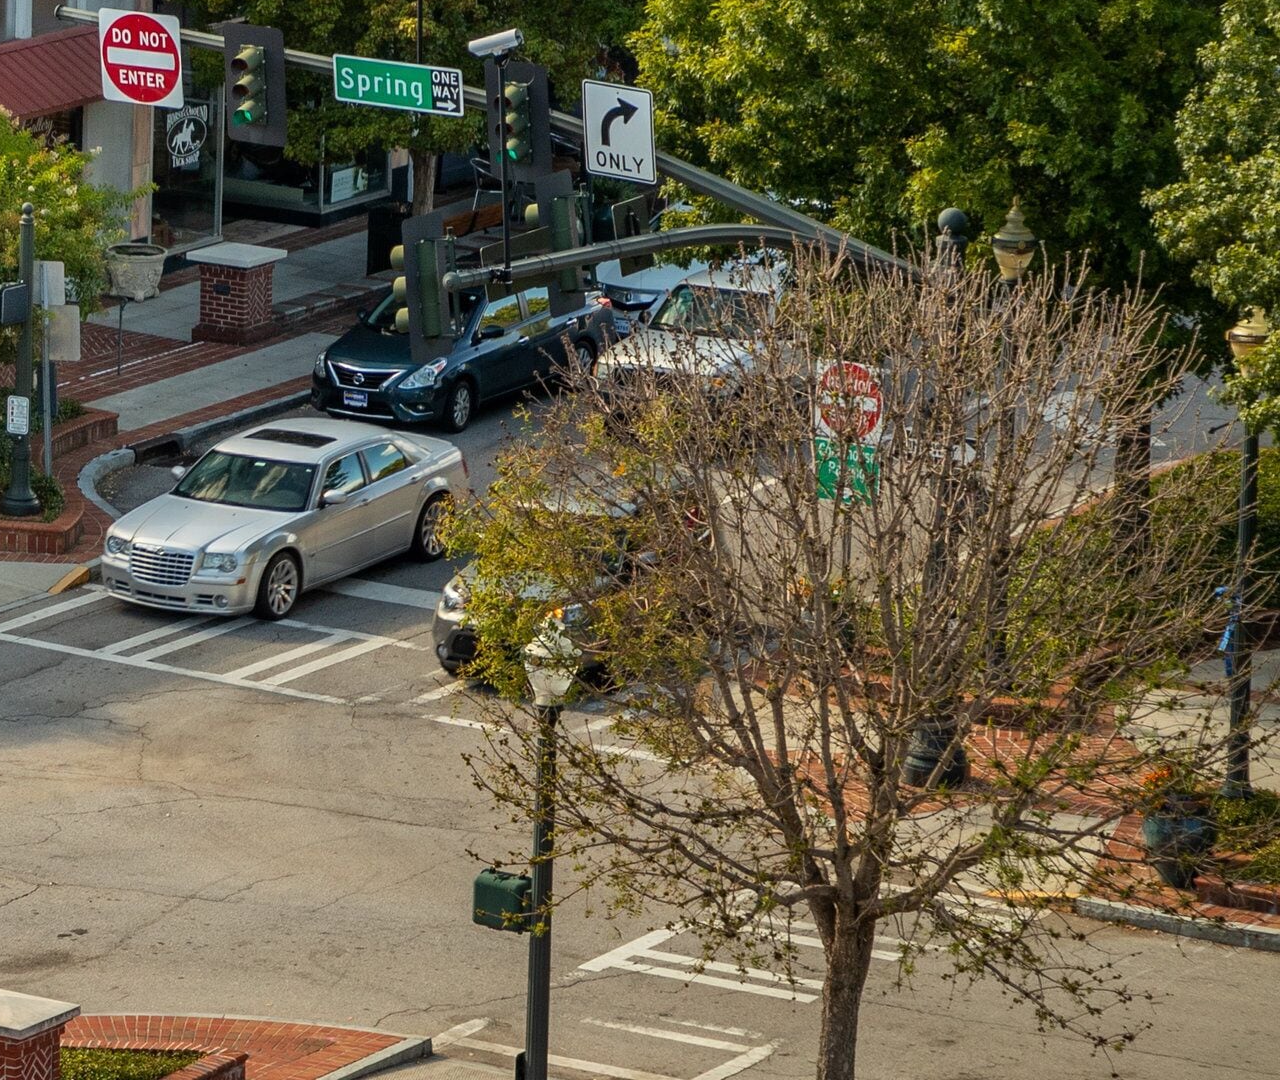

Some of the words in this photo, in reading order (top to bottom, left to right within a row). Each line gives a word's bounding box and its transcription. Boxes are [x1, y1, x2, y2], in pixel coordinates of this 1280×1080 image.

[112, 27, 131, 44] DO
[139, 31, 168, 49] NOT
[119, 69, 165, 89] ENTER
[340, 67, 423, 106] Spring
[432, 71, 458, 86] ONE
[432, 84, 460, 100] WAY
[596, 150, 644, 174] ONLY
